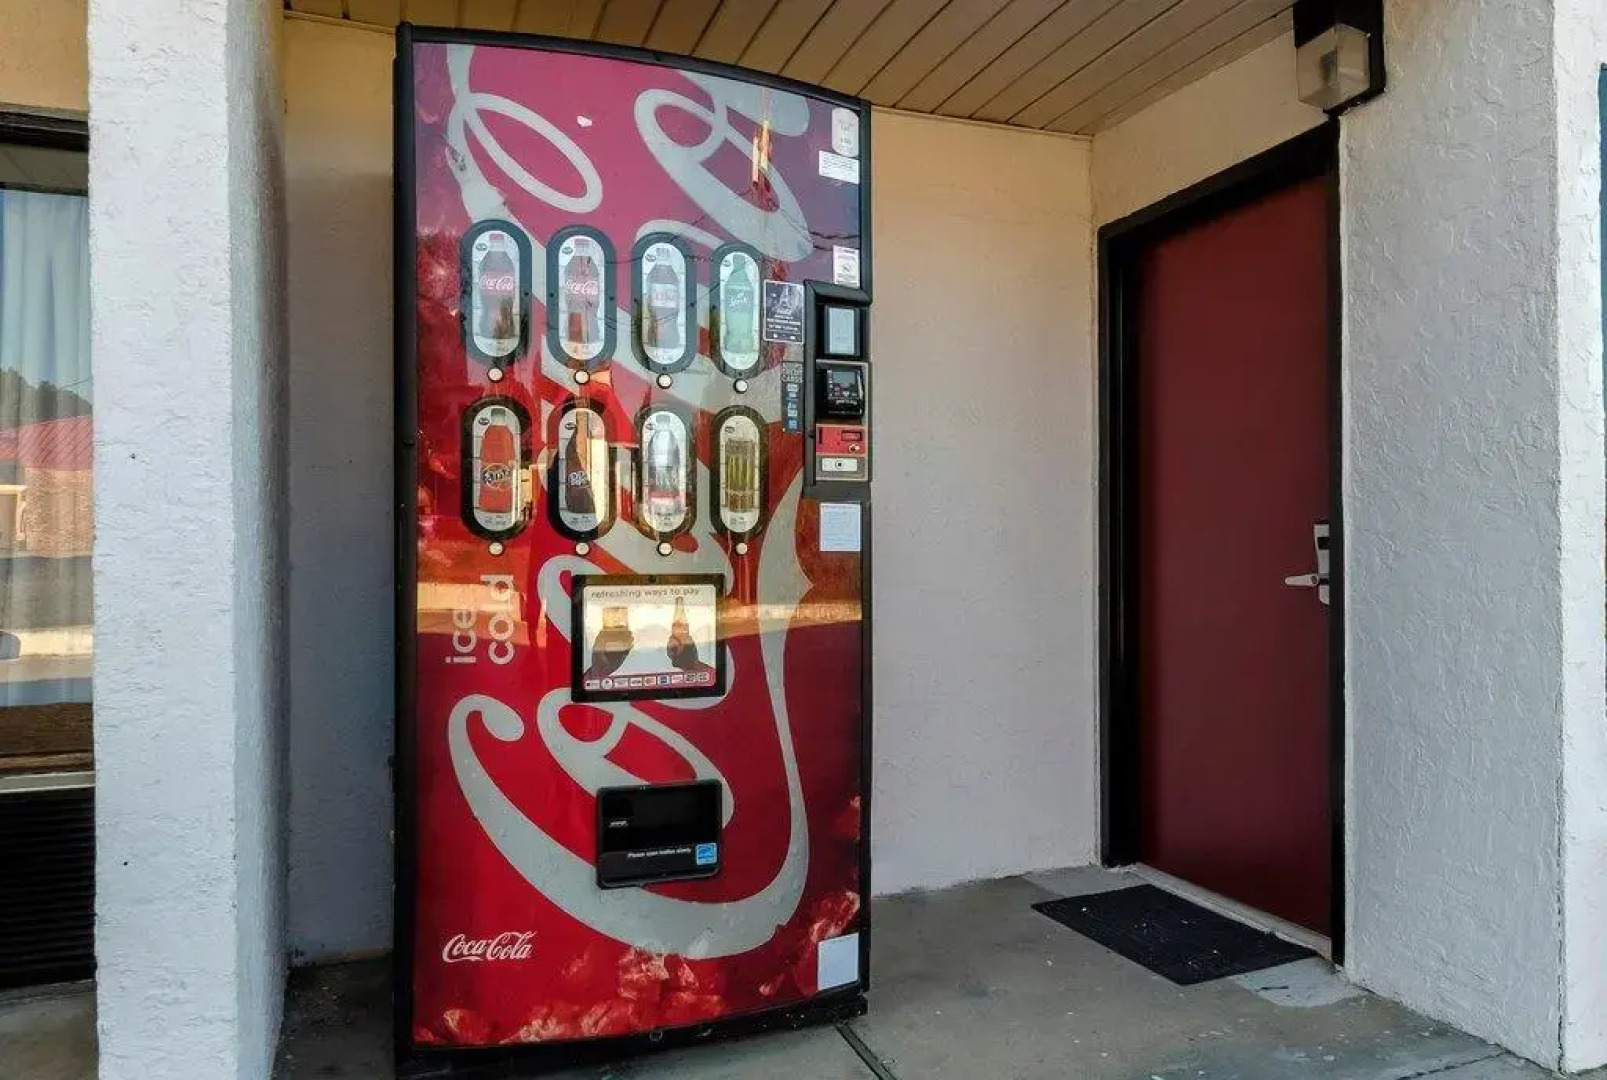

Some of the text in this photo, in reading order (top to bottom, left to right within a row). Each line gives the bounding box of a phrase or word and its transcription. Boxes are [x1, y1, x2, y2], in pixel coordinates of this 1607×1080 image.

[591, 587, 699, 599] refreshing ways to pay
[445, 608, 476, 663] ice
[480, 574, 514, 664] cold
[442, 931, 537, 963] Coca-Cola
